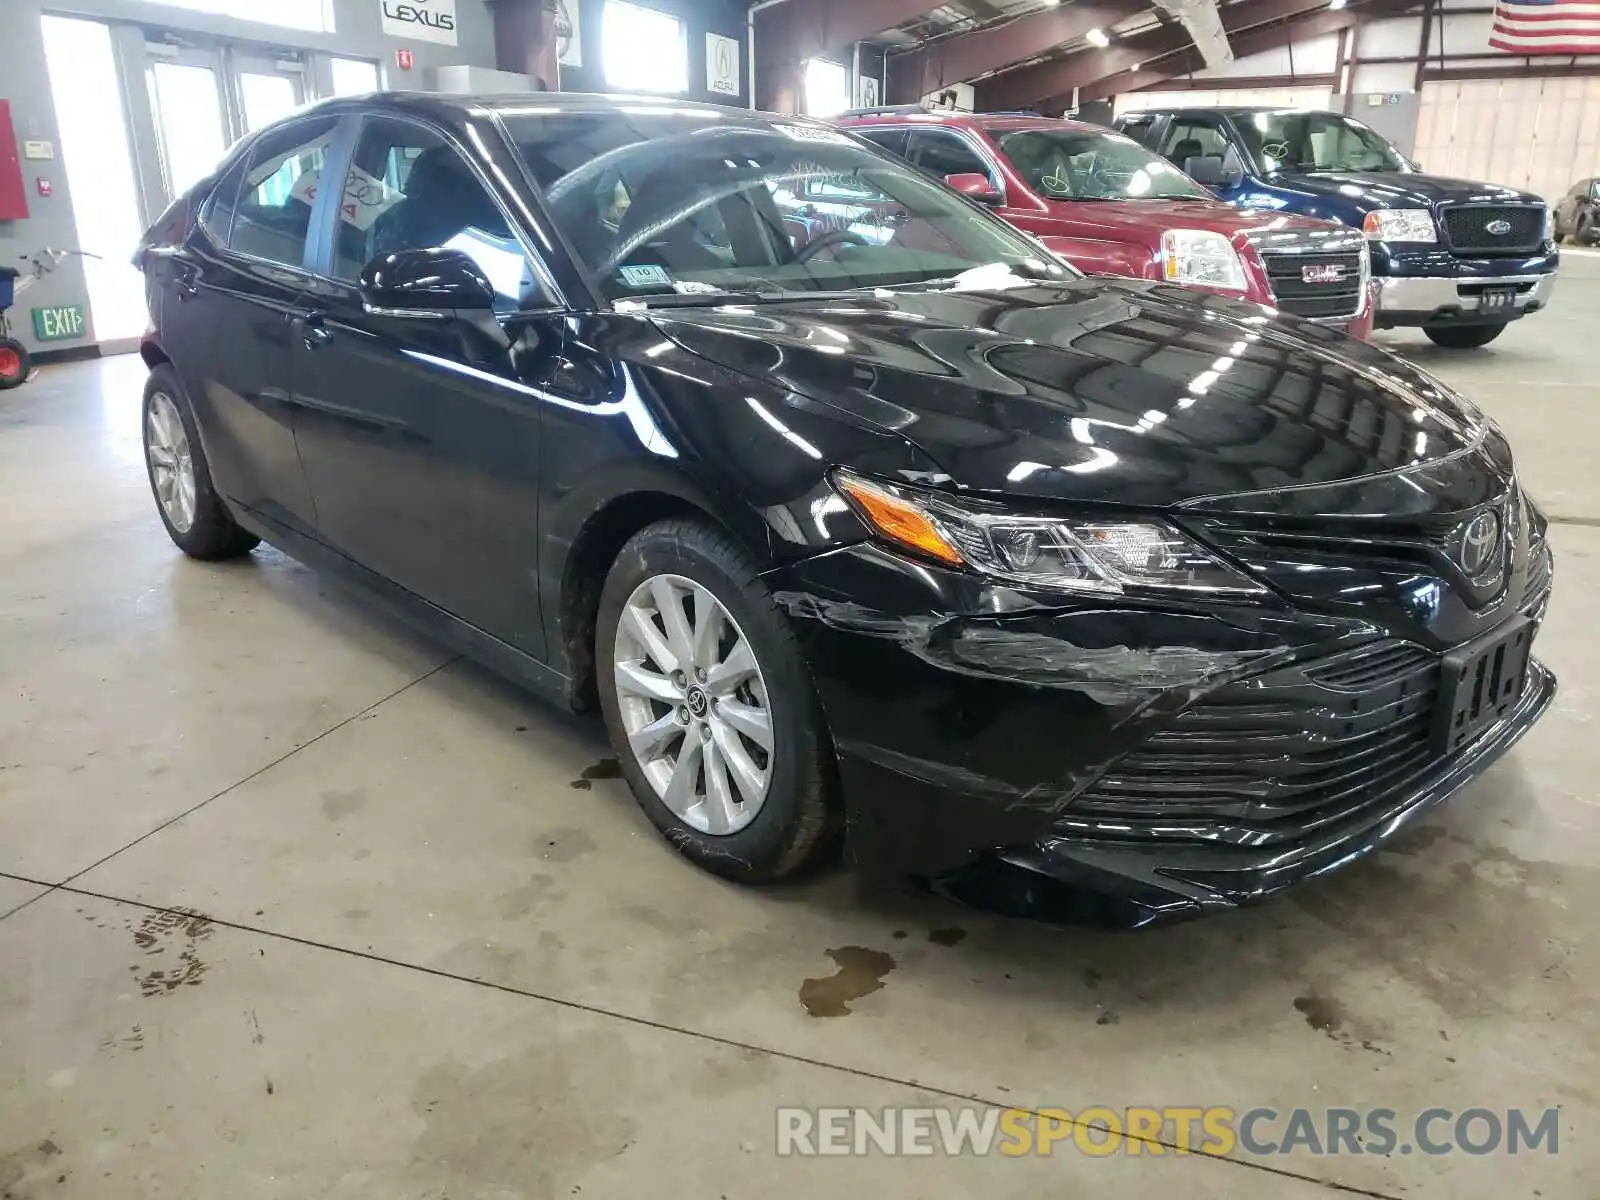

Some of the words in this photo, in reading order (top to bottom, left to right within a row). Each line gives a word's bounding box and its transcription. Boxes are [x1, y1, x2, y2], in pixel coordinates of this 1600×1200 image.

[383, 1, 453, 30] LEXUS
[713, 79, 734, 91] ACURA
[42, 307, 78, 336] EXIT
